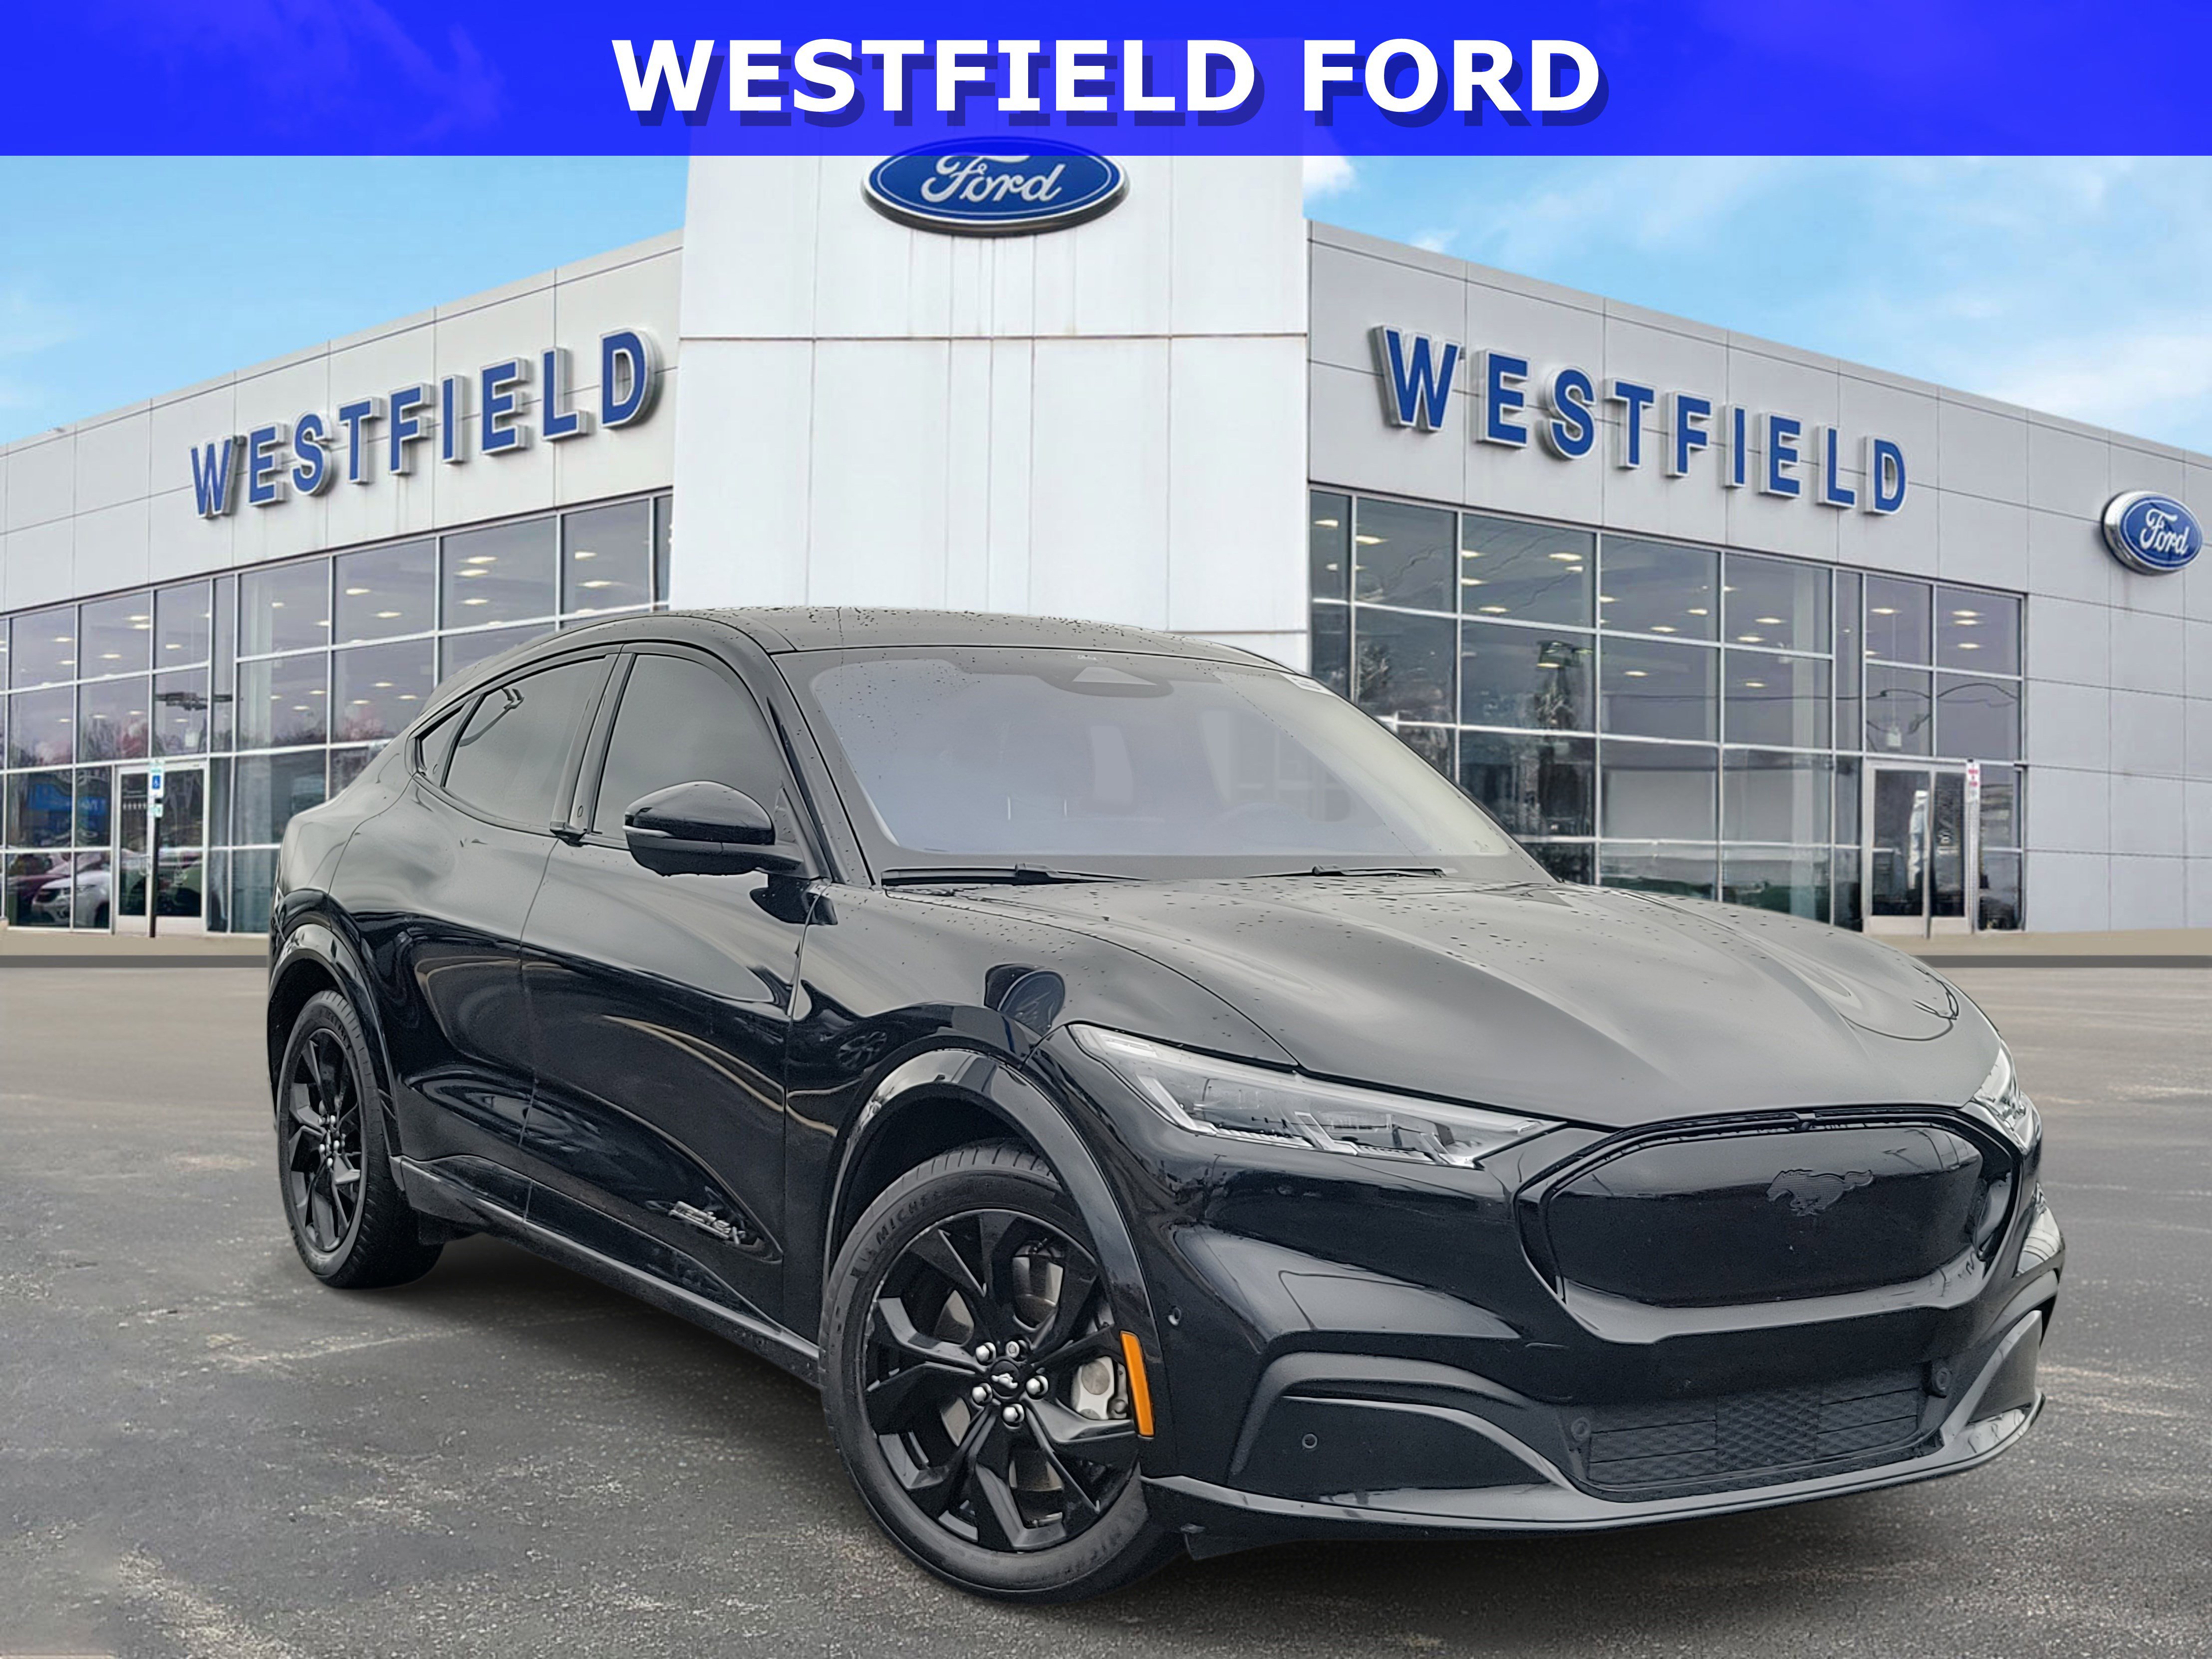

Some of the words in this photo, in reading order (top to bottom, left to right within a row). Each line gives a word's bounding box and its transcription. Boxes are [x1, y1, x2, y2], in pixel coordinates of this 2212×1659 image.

[190, 328, 660, 519] WESTFIELD
[1374, 324, 1908, 515] WESTFIELD
[2140, 508, 2190, 555] Ford
